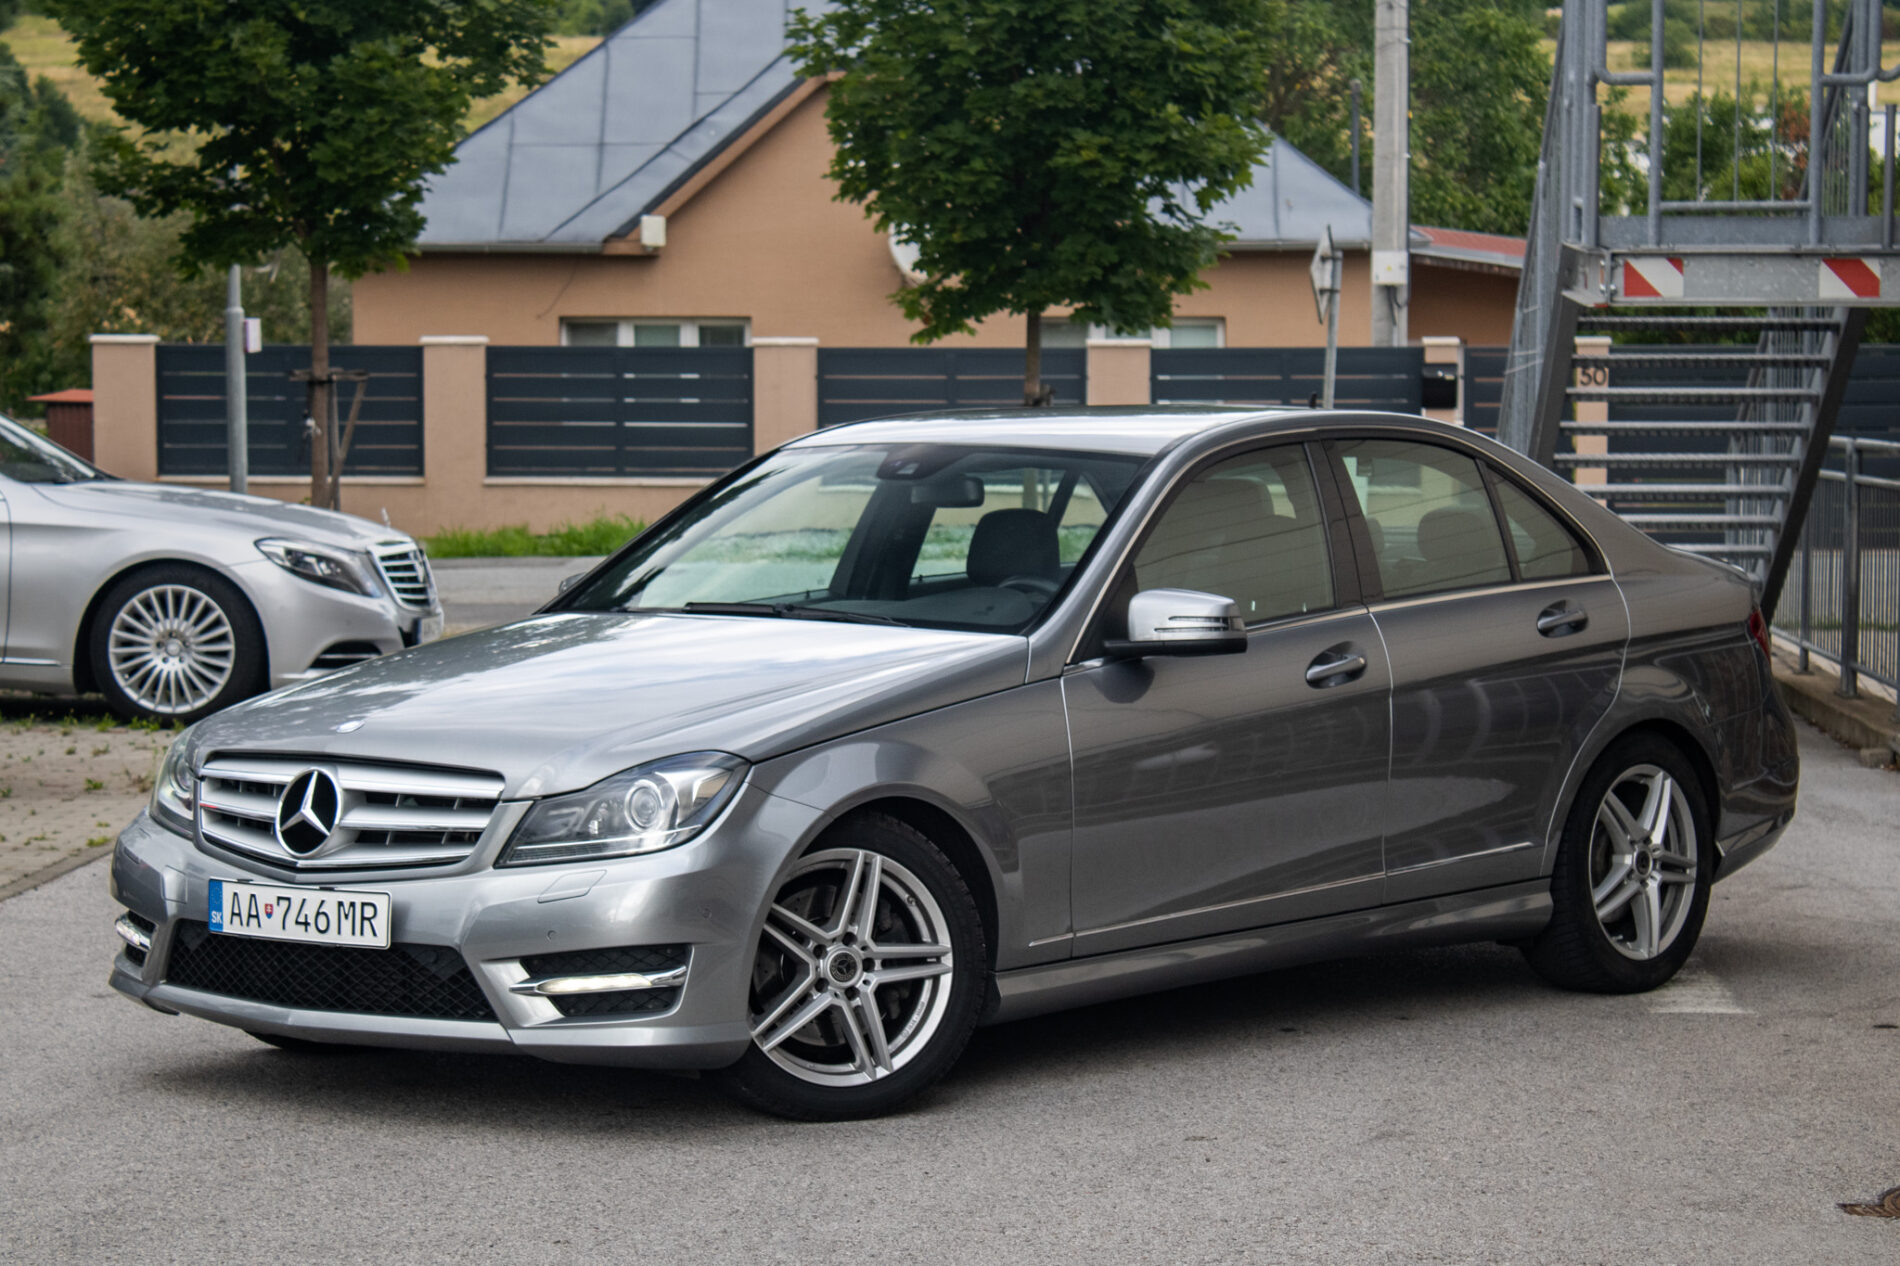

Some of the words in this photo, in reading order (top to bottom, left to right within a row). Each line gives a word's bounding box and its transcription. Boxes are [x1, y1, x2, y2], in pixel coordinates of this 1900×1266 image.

[1580, 366, 1607, 386] 50
[211, 910, 223, 925] SK
[230, 891, 262, 928] AA
[276, 895, 378, 938] 746MR
